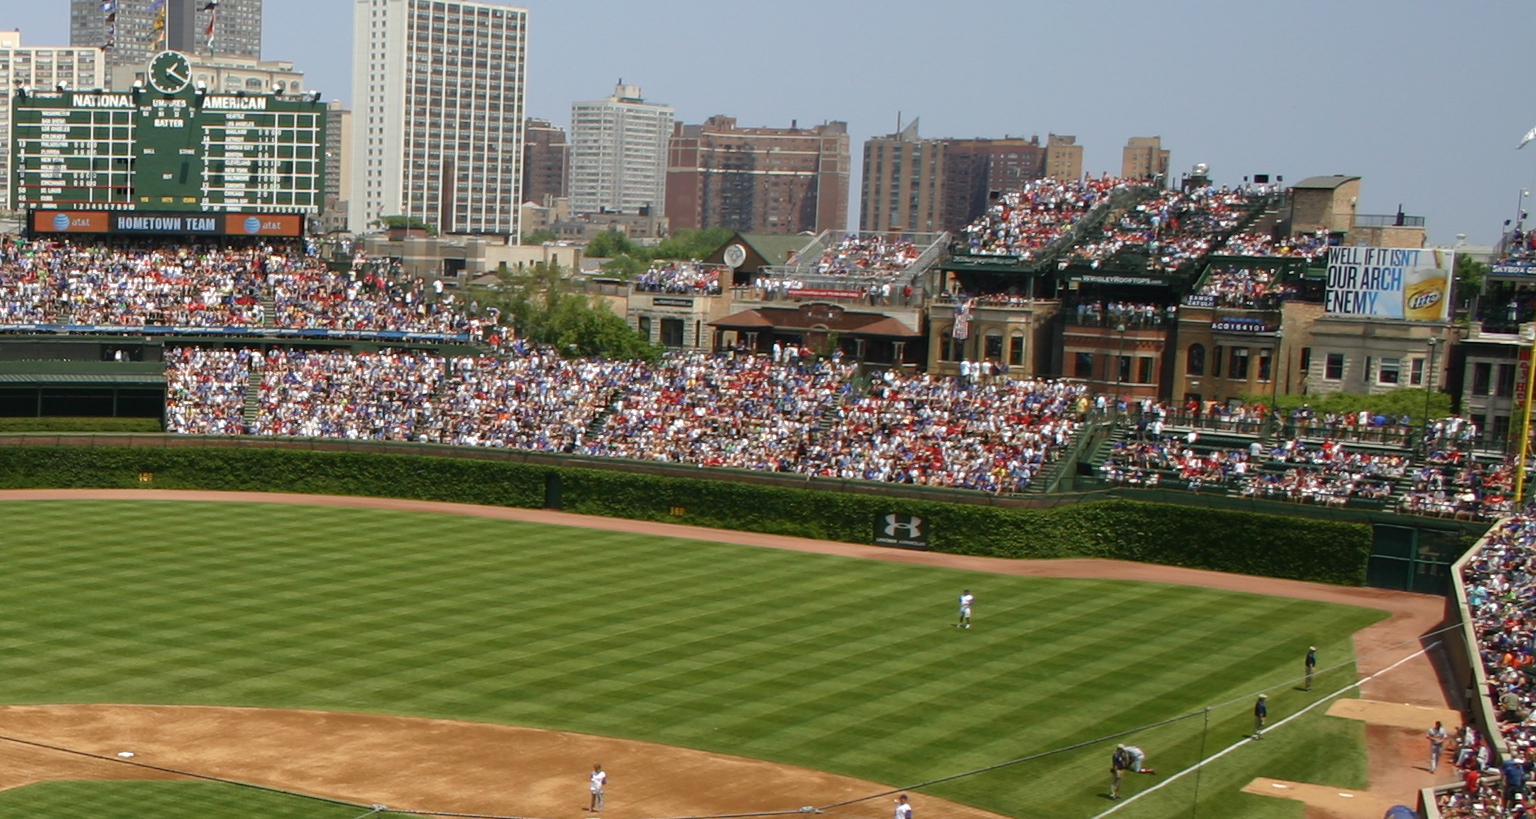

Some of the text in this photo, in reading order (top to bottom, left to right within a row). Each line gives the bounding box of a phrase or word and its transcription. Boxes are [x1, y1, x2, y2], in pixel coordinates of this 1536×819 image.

[73, 94, 136, 107] NATIONAL
[202, 96, 266, 109] AMERICAN
[154, 119, 184, 127] BATTER
[72, 218, 90, 227] at&t
[118, 217, 215, 231] HOMETOWN TEAM
[262, 221, 281, 230] at&t
[1330, 248, 1420, 267] WELL, IF IT ISN'T
[1492, 264, 1524, 273] SKYBOX
[1327, 266, 1402, 291] OUR ARCH
[1326, 290, 1378, 315] ENEMY.
[1413, 292, 1438, 308] Lite
